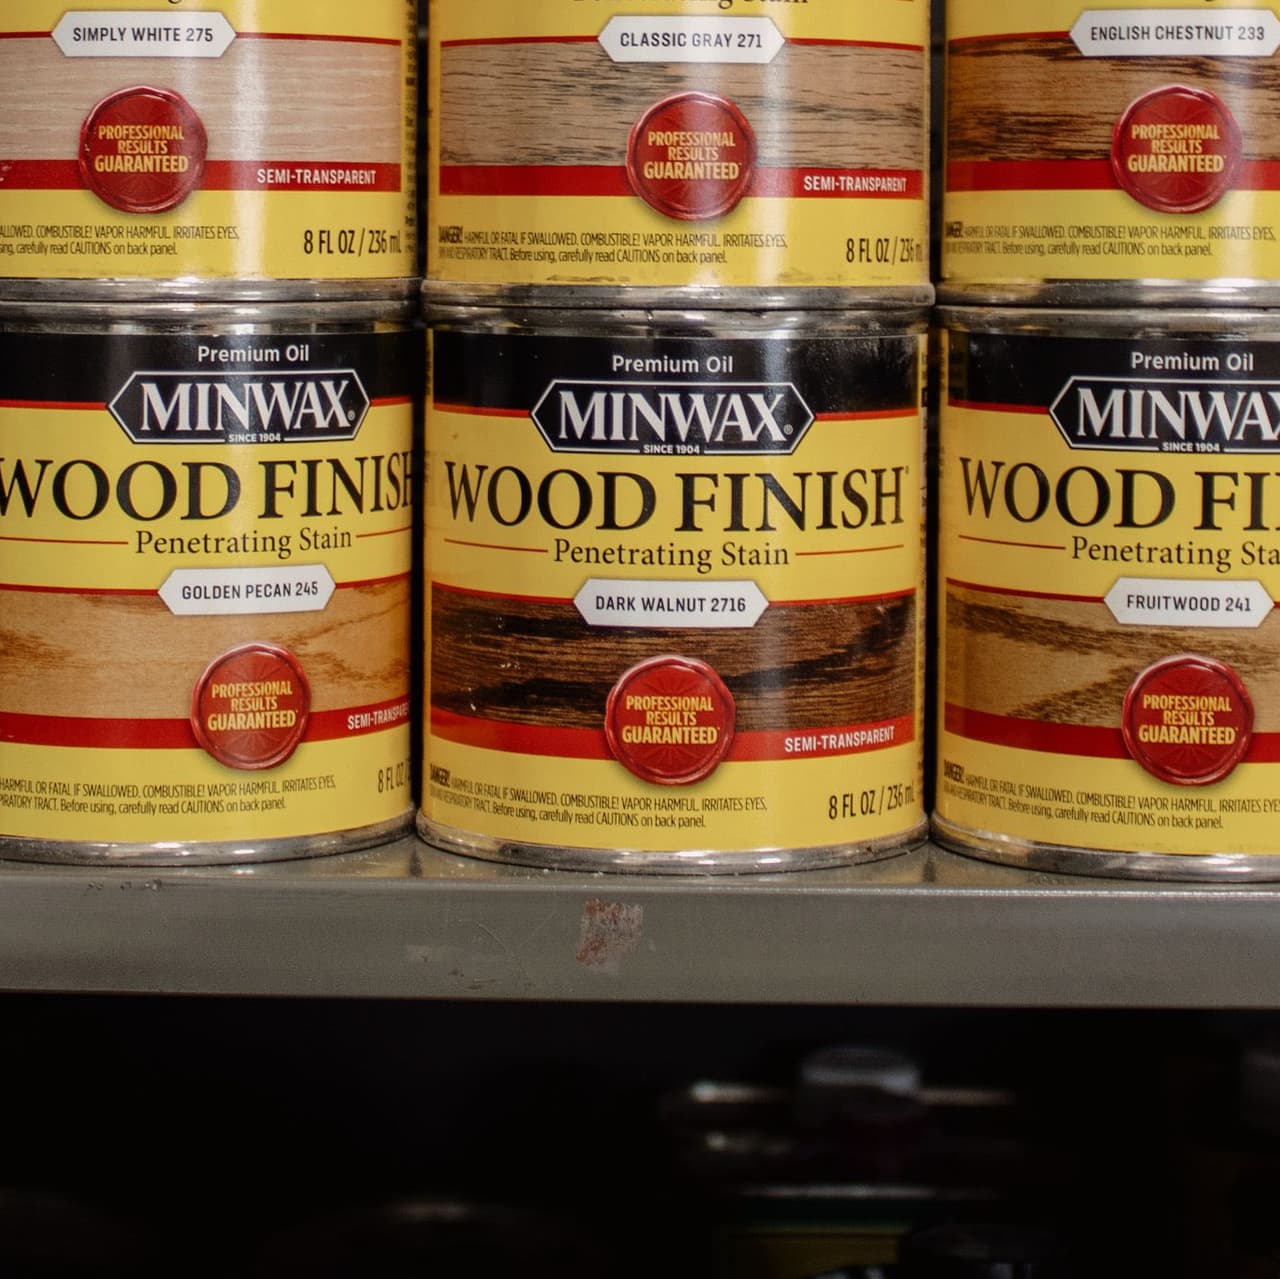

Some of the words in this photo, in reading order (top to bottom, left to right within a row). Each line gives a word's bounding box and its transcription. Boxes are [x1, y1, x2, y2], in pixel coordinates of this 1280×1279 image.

[73, 27, 127, 41] SIMPLY
[132, 27, 180, 41] WHITE
[186, 27, 214, 42] 275
[620, 32, 687, 47] CLASSIC
[691, 32, 732, 48] GRAY
[738, 33, 761, 48] 271
[1090, 26, 1150, 41] ENGLISH
[1155, 25, 1234, 41] CHESTNUT
[1239, 26, 1265, 41] 233
[98, 126, 185, 141] PROFESSIONAL
[118, 140, 168, 155] RESULTS
[95, 156, 188, 173] GUARANTEED
[257, 169, 376, 185] SEMI-TRANSPARENT
[141, 381, 349, 431] MINWAX
[559, 391, 786, 442] MINWAX
[1162, 442, 1193, 452] SINCE
[1195, 443, 1220, 453] 1904
[445, 460, 656, 531] WOOD
[675, 467, 905, 533] FINISH
[960, 457, 1175, 528] WOOD
[182, 584, 241, 600] GOLDEN
[246, 583, 292, 599] PECAN
[296, 581, 319, 597] 245
[596, 597, 636, 611] DARK
[642, 597, 706, 612] WALNUT
[711, 597, 746, 612] 2716
[1126, 595, 1220, 611] FRUITWOOD
[1225, 597, 1251, 612] 241
[785, 726, 895, 752] SEMI-TRANSPARENT
[829, 795, 837, 819] 8
[843, 793, 856, 818] FL
[861, 790, 875, 815] OZ
[879, 786, 885, 815] /
[888, 784, 903, 809] 236
